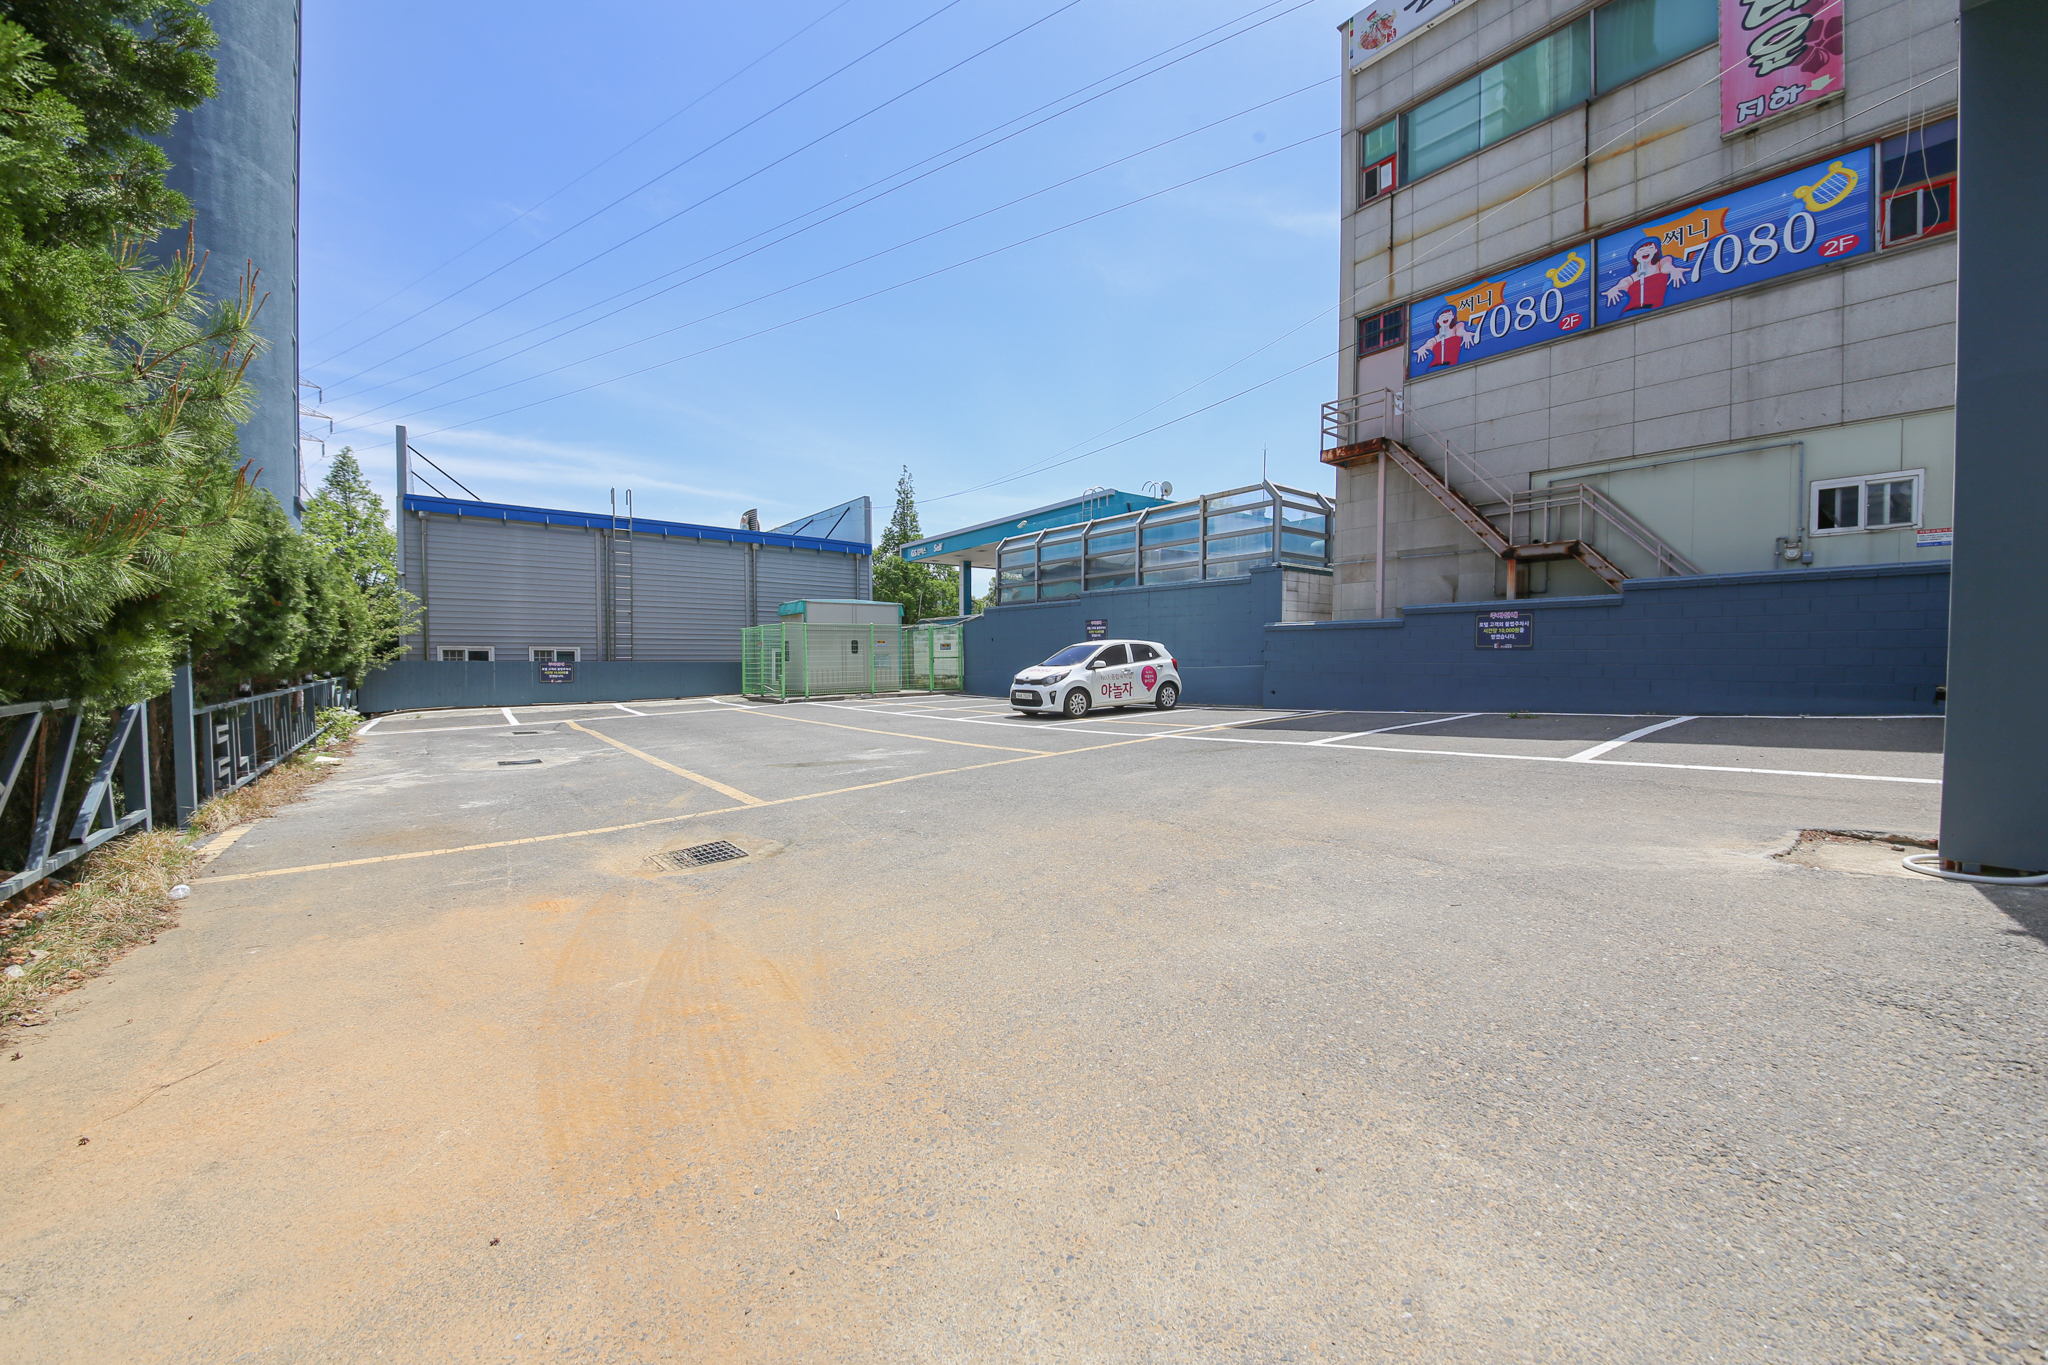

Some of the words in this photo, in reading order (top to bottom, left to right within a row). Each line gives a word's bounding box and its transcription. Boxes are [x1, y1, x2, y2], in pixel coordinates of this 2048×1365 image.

[1737, 84, 1806, 123] 지하
[1661, 218, 1710, 246] 써니
[1683, 211, 1817, 283] 7080
[1824, 235, 1855, 256] 2F
[1457, 289, 1493, 312] 써니
[1468, 288, 1564, 344] 7080
[1561, 313, 1580, 330] 2F
[1101, 681, 1133, 699] 야놀자
